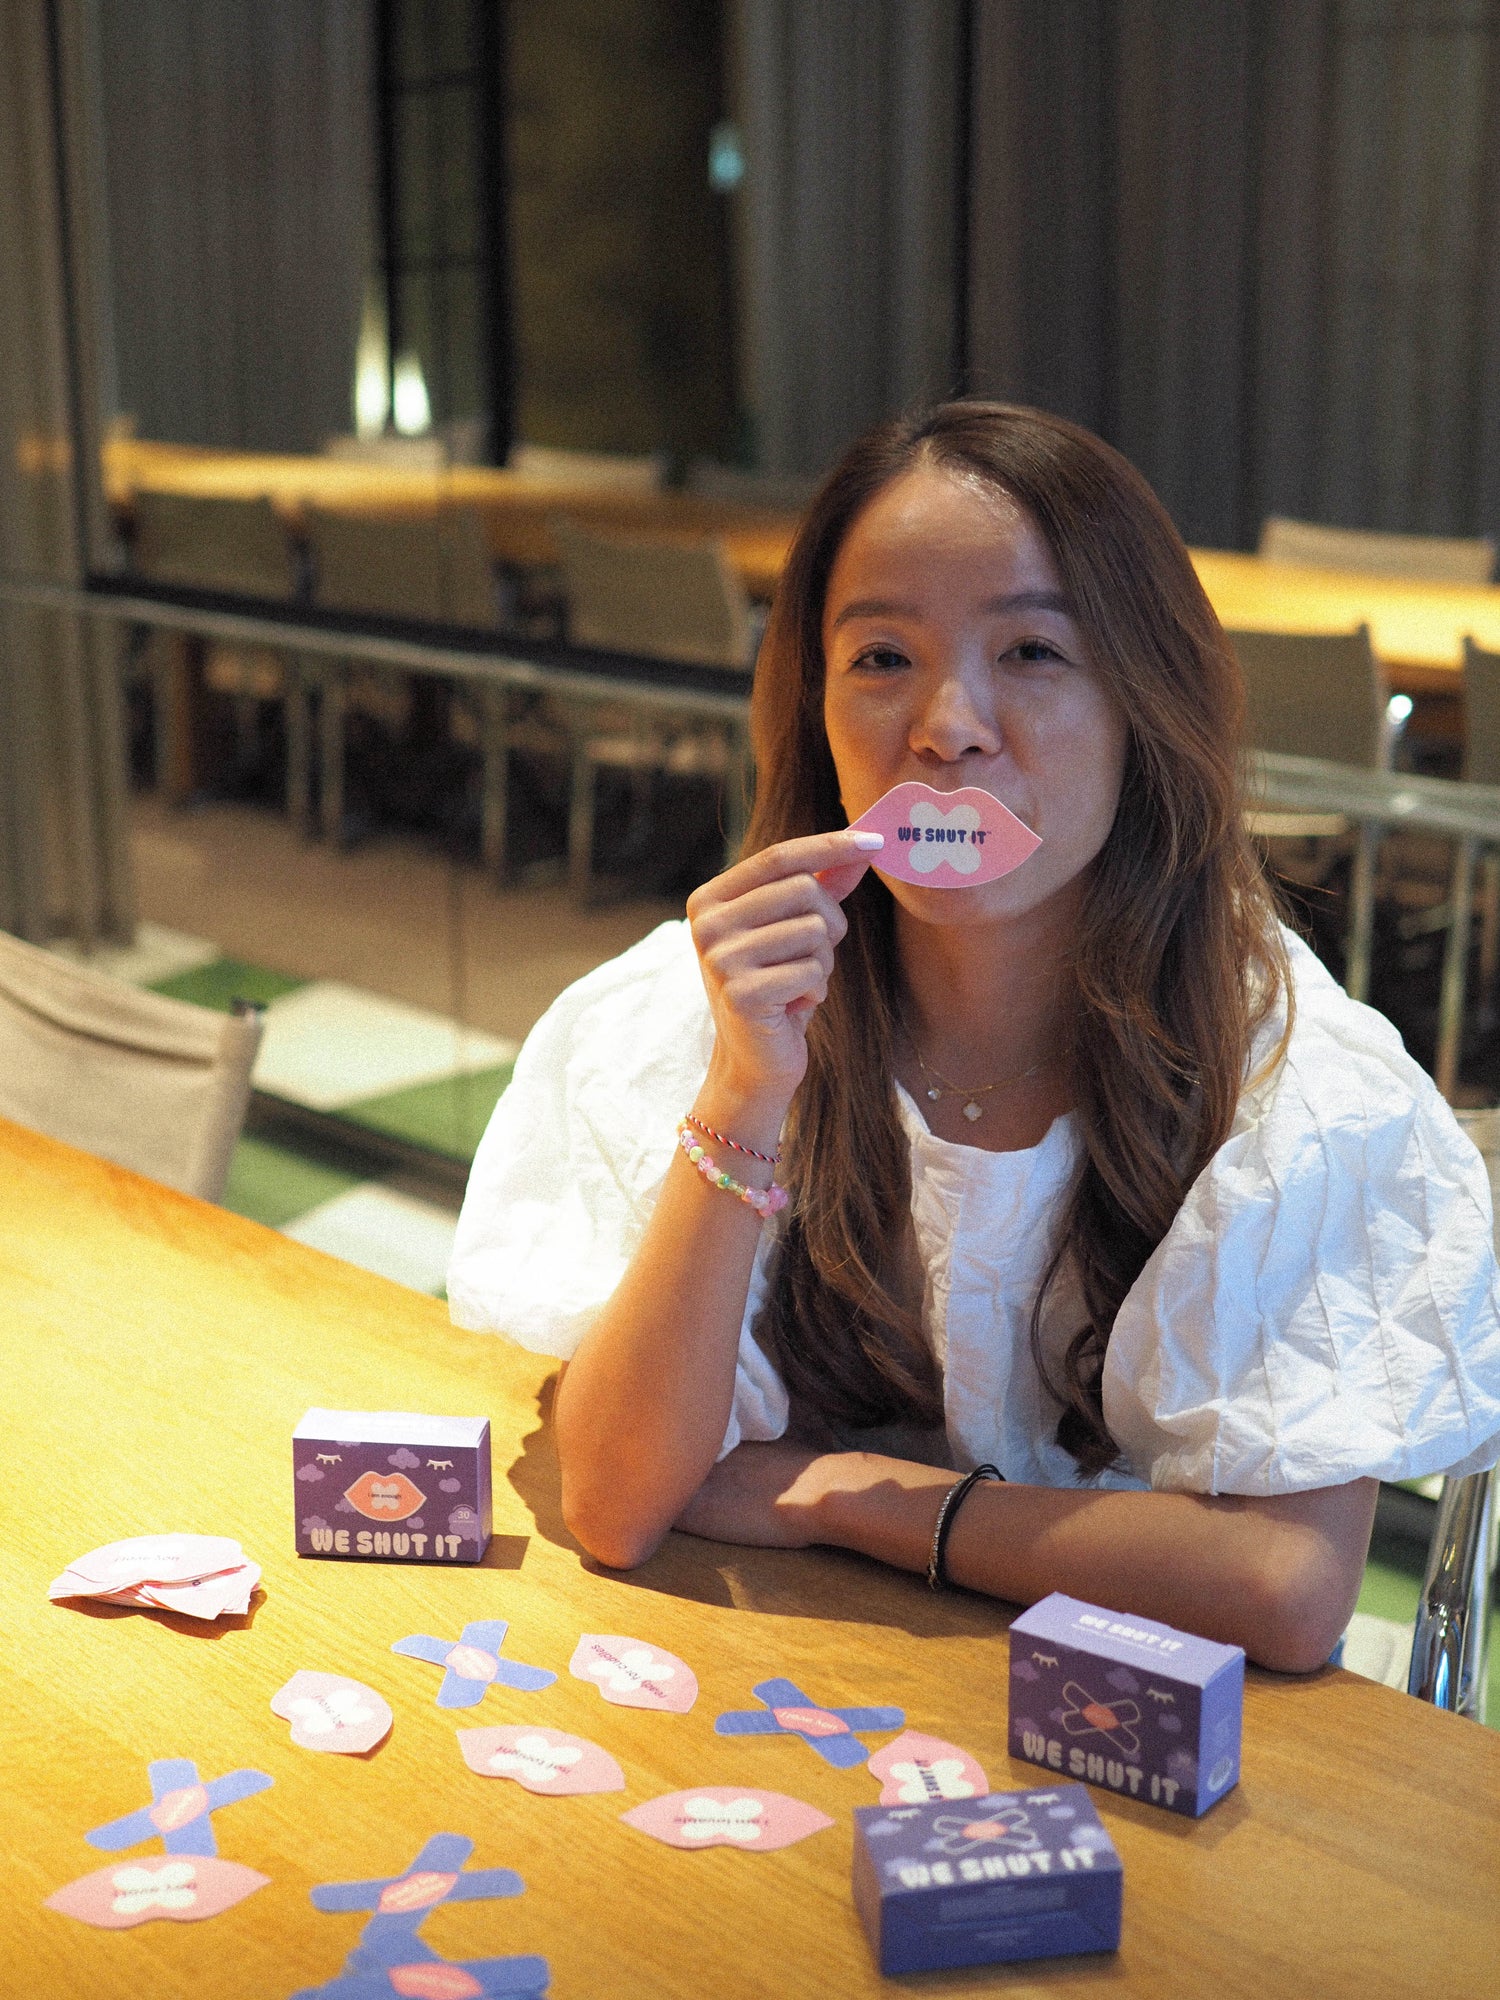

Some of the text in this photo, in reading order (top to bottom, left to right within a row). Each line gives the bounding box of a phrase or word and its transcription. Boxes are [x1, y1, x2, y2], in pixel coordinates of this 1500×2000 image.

[898, 827, 921, 842] WE
[925, 828, 967, 843] SHUT
[457, 1510, 470, 1519] 30
[310, 1527, 462, 1558] WE SHUT IT
[1023, 1730, 1062, 1768] WE
[1069, 1747, 1143, 1794] SHUT
[1151, 1774, 1180, 1806] IT
[899, 1845, 1095, 1889] WE SHUT IT
